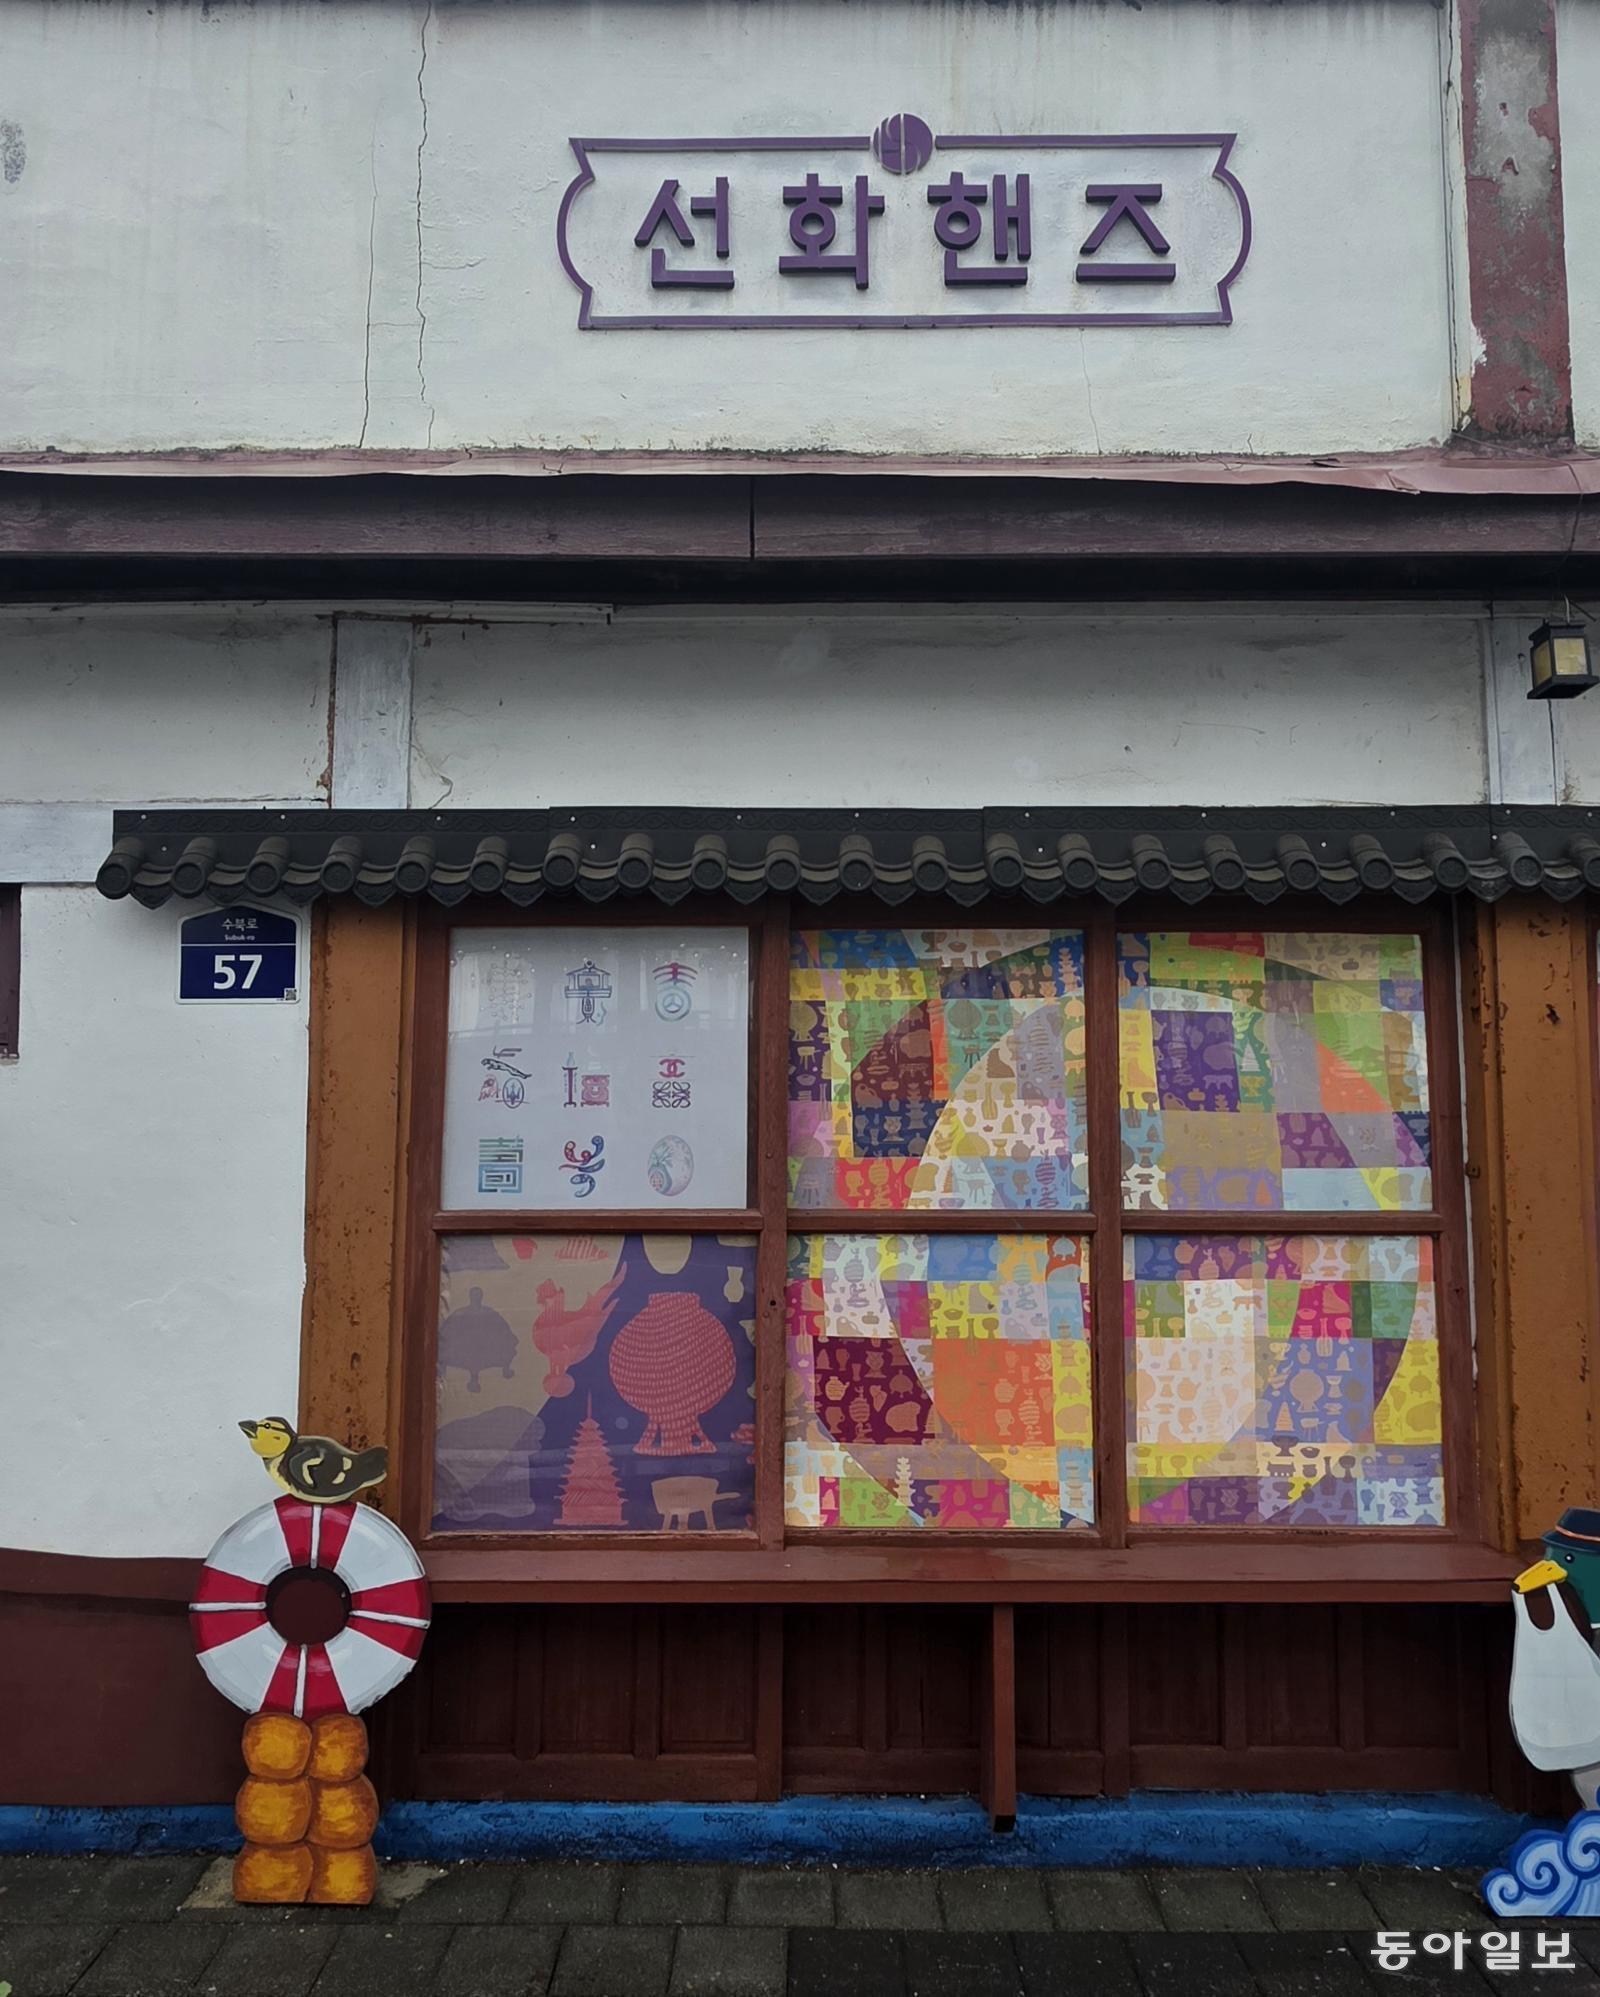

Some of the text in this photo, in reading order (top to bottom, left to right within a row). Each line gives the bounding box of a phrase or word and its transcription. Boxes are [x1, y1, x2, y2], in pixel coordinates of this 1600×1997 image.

[634, 171, 1176, 290] 선화핸즈
[222, 918, 259, 931] 수북로
[213, 954, 263, 990] 57
